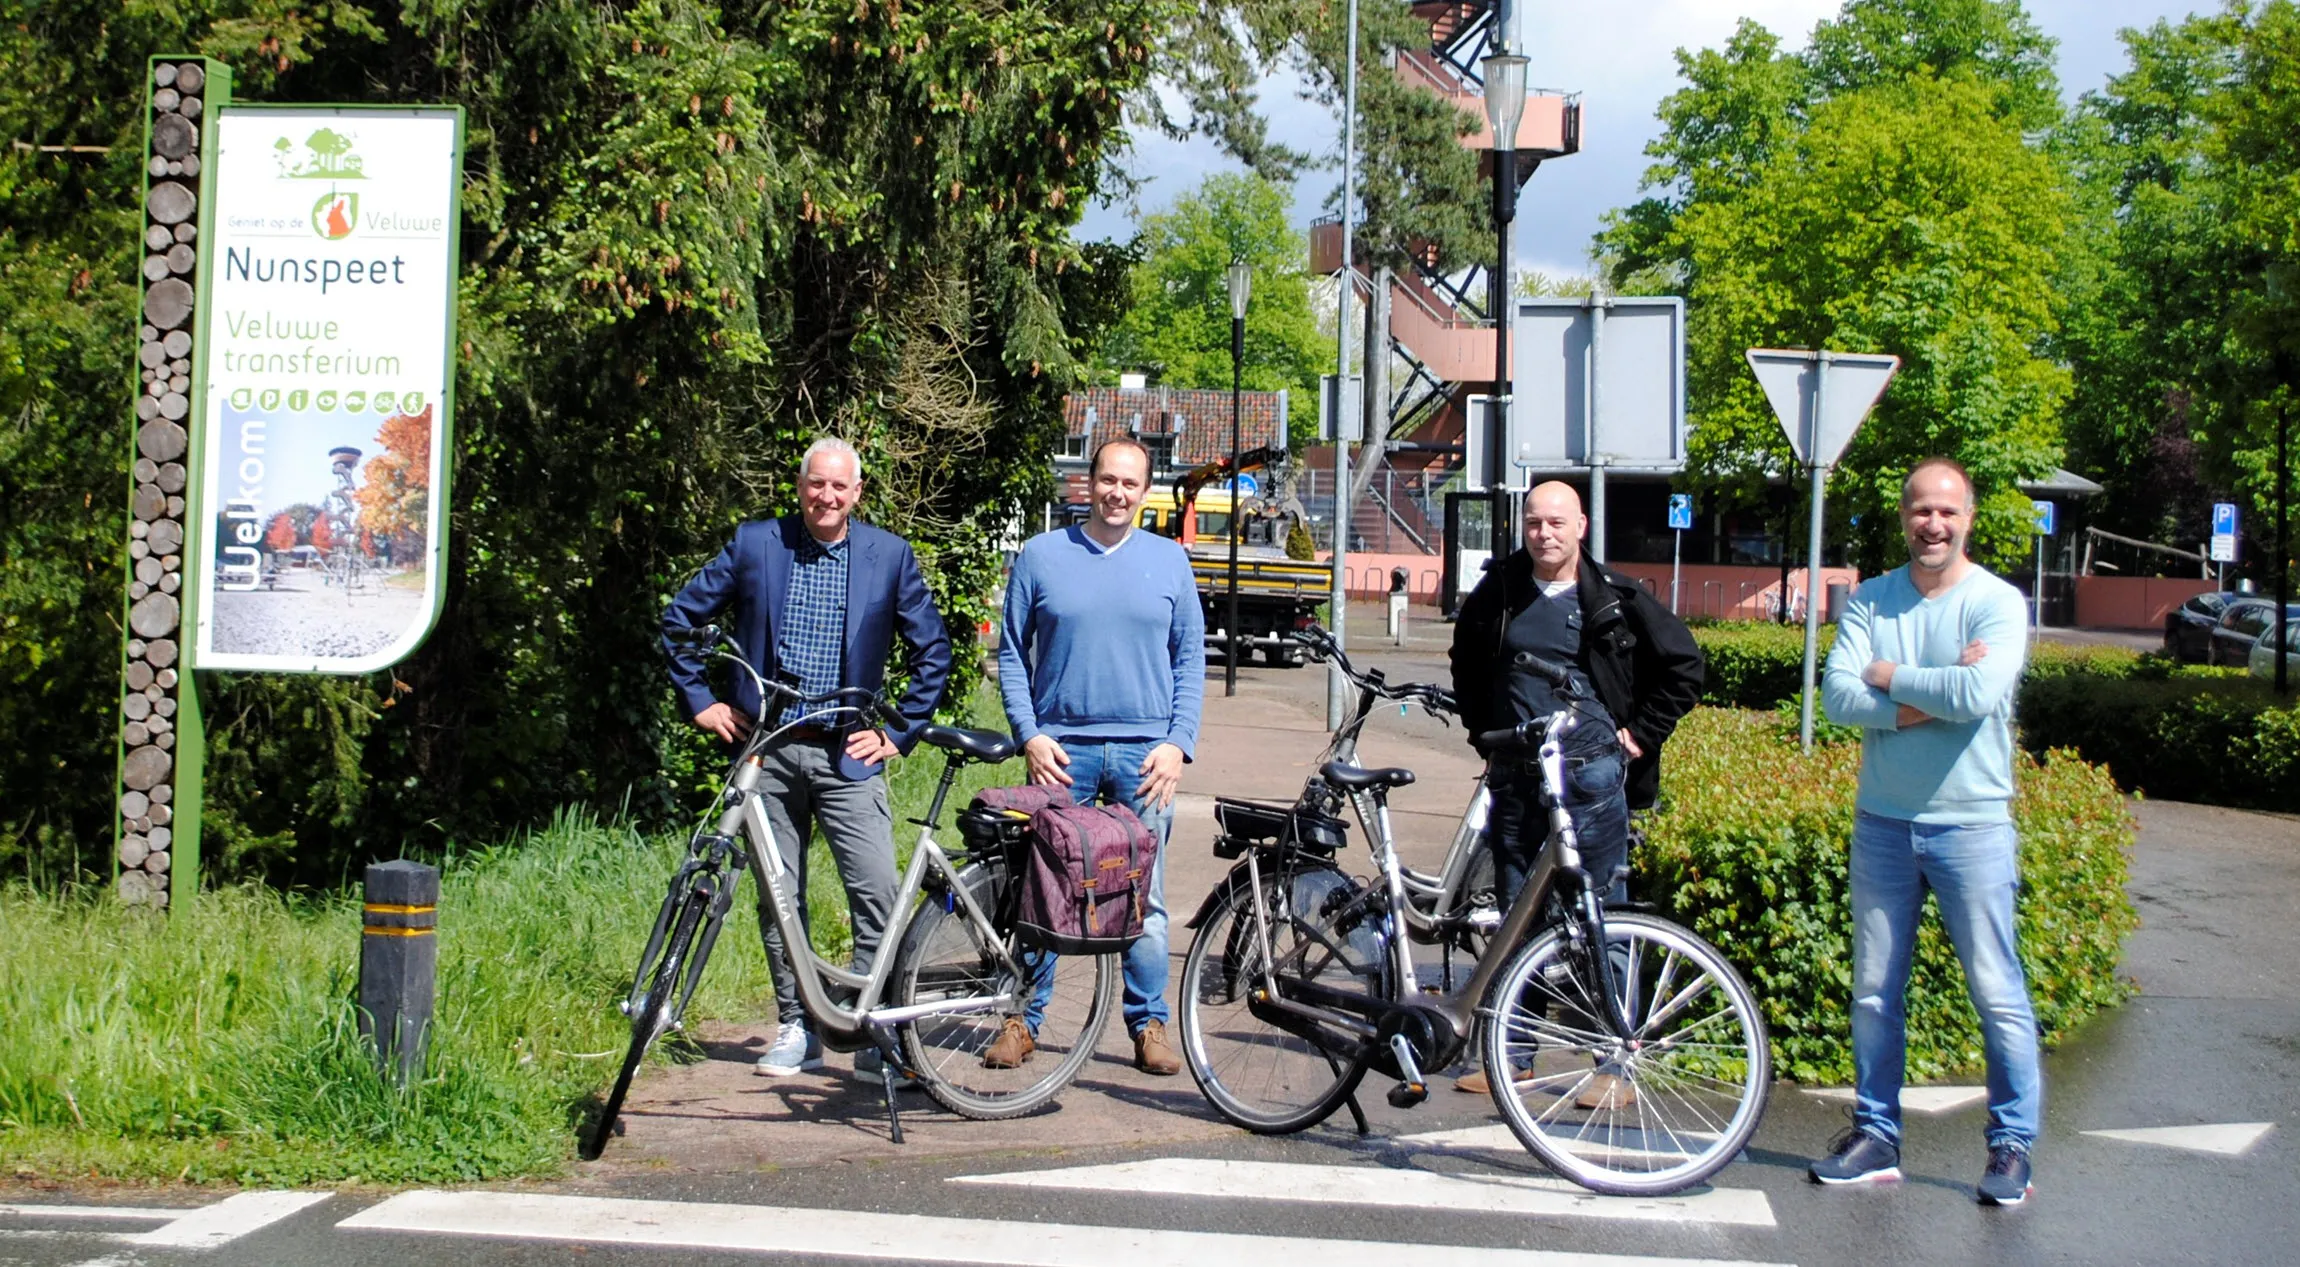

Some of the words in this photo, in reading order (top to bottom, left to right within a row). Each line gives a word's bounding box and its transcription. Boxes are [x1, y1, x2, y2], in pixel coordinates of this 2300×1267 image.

[228, 215, 266, 229] Geniet
[269, 217, 286, 231] op
[288, 215, 304, 229] de
[366, 211, 442, 232] Veluwe
[227, 246, 405, 295] Nunspeet
[226, 310, 339, 340] Veluwe
[225, 346, 401, 376] transferium
[223, 420, 267, 592] Welkom
[2219, 506, 2231, 523] P
[769, 872, 792, 922] STELLA
